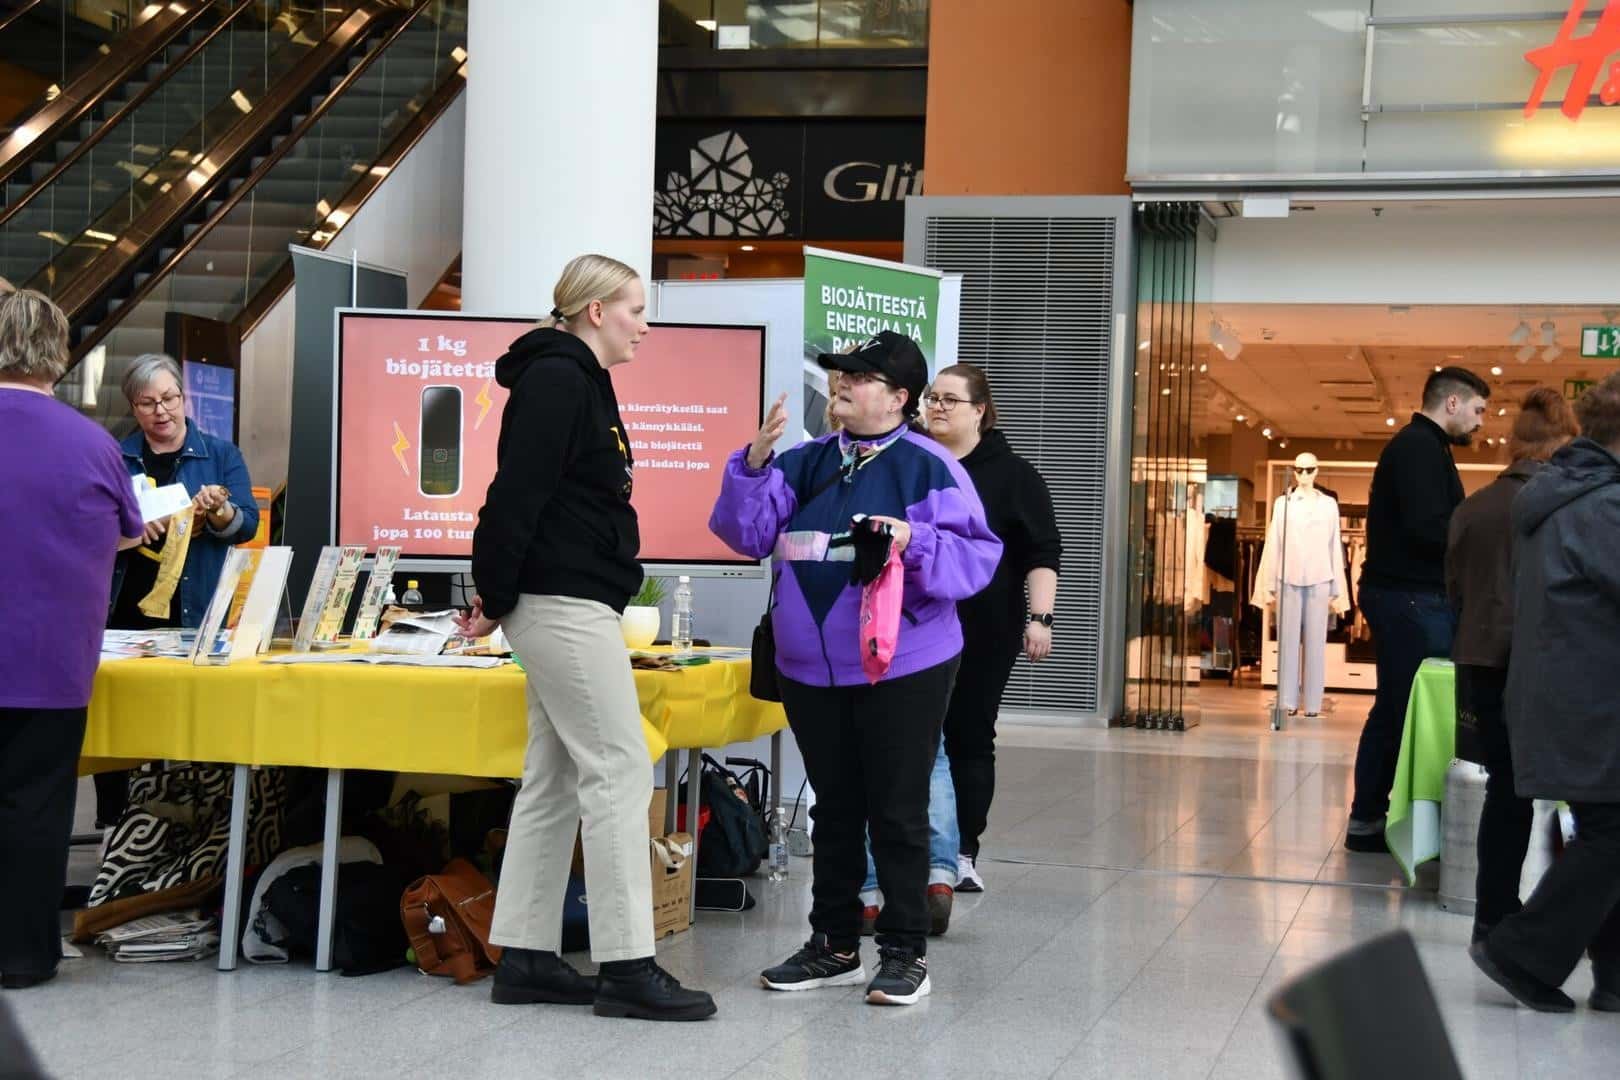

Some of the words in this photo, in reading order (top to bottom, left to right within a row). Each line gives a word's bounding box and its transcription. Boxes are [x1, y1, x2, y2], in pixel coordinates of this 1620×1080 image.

[821, 284, 928, 320] BIOJÄTTEESTÄ
[417, 338, 430, 352] 1
[437, 335, 467, 357] kg
[386, 358, 497, 379] biojätettä
[687, 461, 710, 471] jopa
[403, 508, 474, 521] Latausta
[373, 526, 409, 541] jopa
[415, 528, 442, 539] 100
[447, 528, 474, 540] tun
